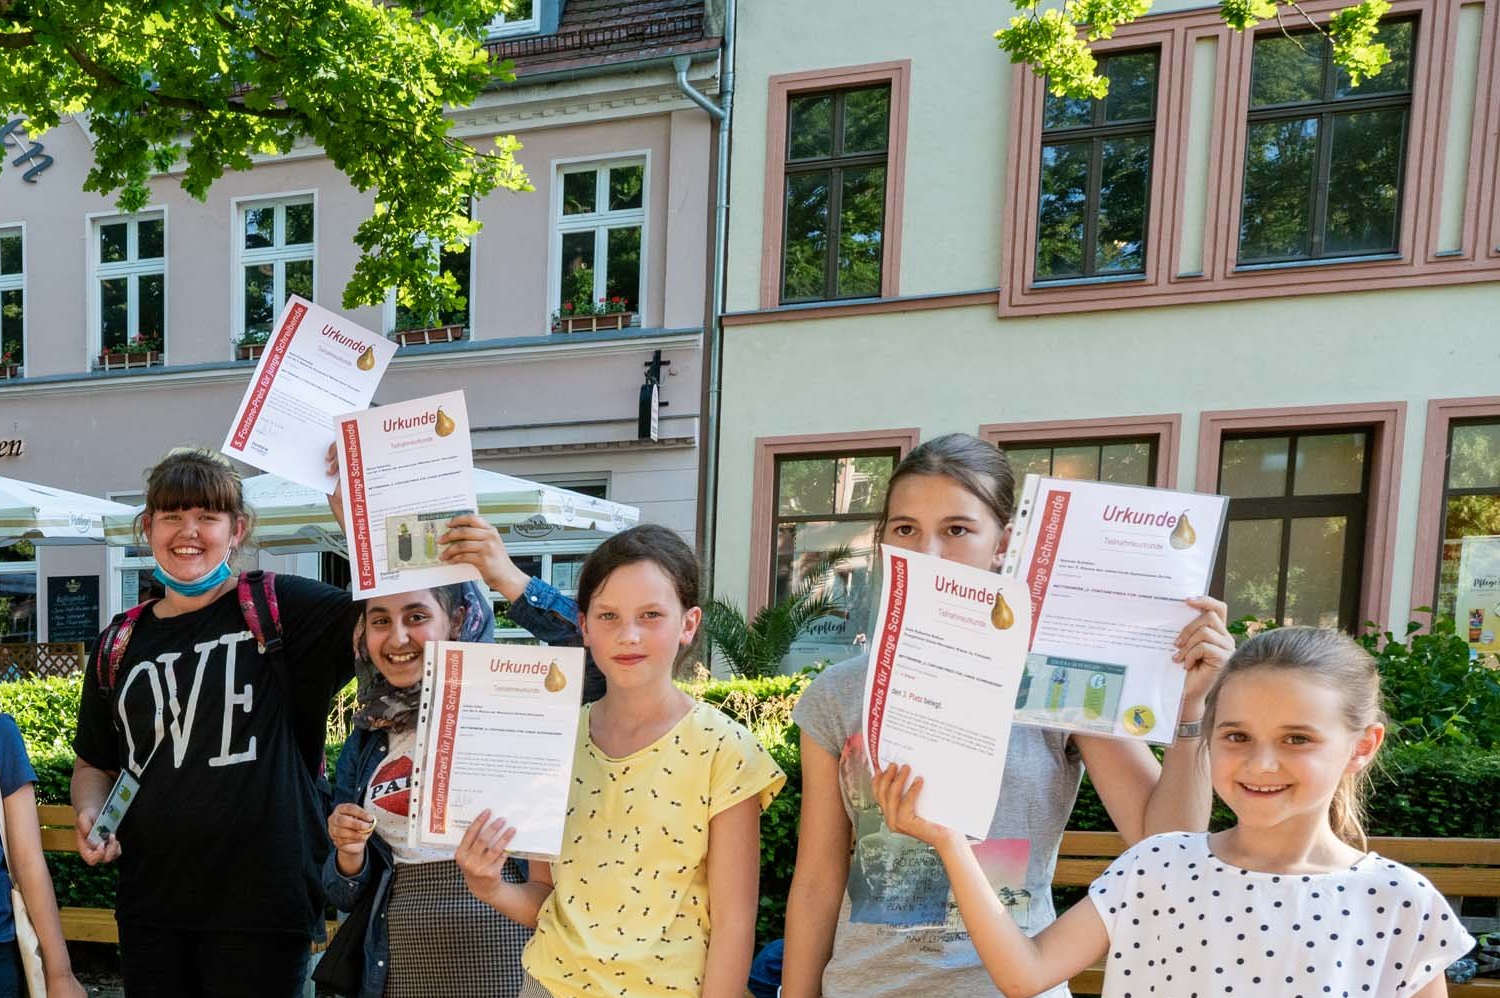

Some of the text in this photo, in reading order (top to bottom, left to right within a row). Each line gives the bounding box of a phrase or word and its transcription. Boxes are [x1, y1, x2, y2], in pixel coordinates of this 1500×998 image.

[321, 324, 365, 354] Urkunde
[239, 388, 266, 440] Fontane-Preis
[260, 376, 270, 390] für
[266, 354, 280, 377] junge
[275, 308, 304, 355] Schreibende
[383, 412, 436, 432] Urkunde
[346, 424, 372, 586] 5. Fontane-Preis für junge Schreibende
[1102, 504, 1177, 528] Urkunde
[1037, 495, 1065, 566] Schreibende
[888, 561, 905, 632] Schreibende
[934, 575, 995, 605] Urkunde
[1030, 566, 1049, 602] junge
[490, 659, 548, 675] Urkunde
[880, 634, 896, 670] junge
[446, 653, 460, 714] Schreibende
[877, 670, 889, 687] für
[444, 712, 458, 743] junge
[441, 742, 451, 756] für
[434, 756, 448, 821] Fontane-Preis
